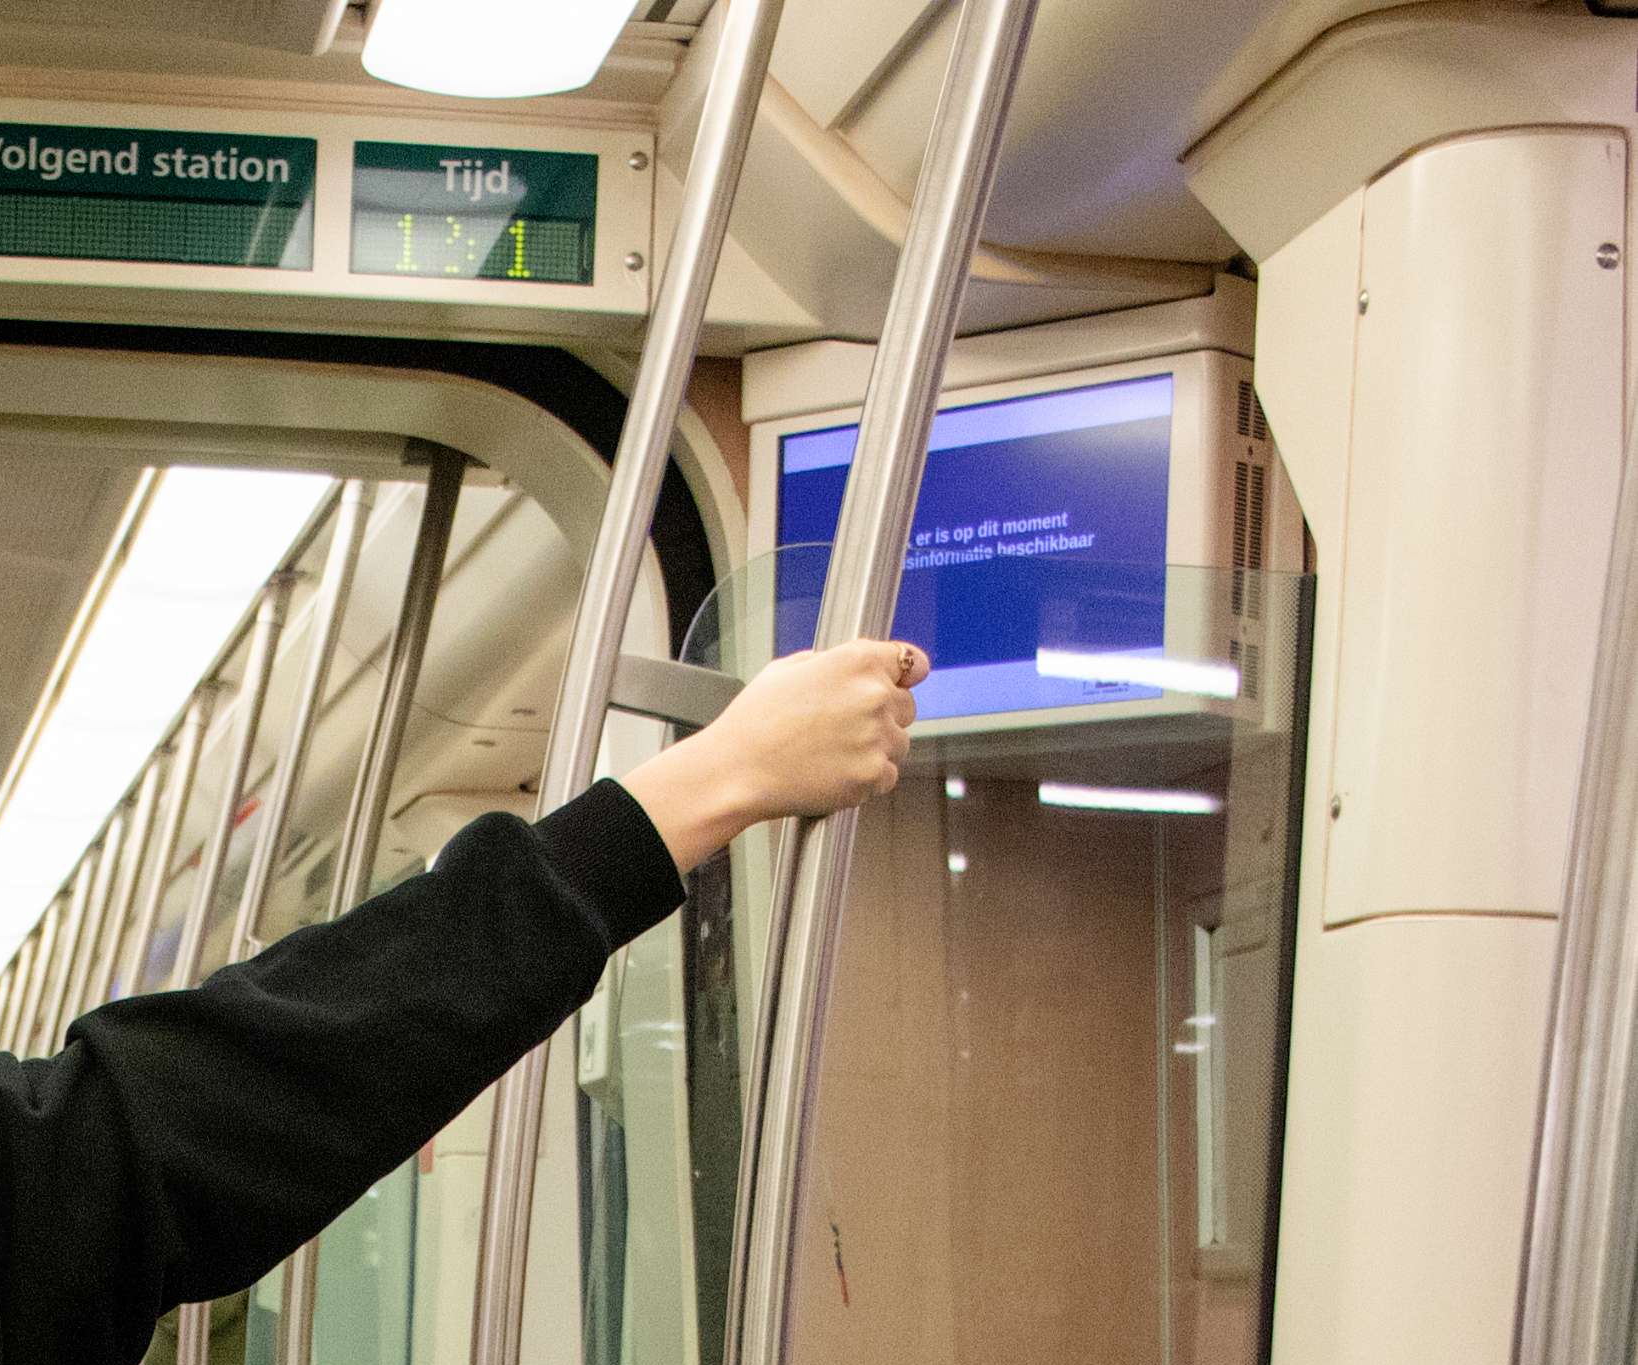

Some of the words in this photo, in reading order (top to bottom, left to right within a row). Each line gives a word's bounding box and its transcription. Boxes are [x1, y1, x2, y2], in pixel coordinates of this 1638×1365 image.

[152, 144, 291, 185] station
[437, 158, 510, 201] Tijd
[915, 531, 932, 547] er
[935, 526, 950, 544] is
[953, 525, 975, 544] op
[978, 519, 999, 539] dit
[1002, 511, 1069, 536] moment
[997, 533, 1096, 557] beschikbaar
